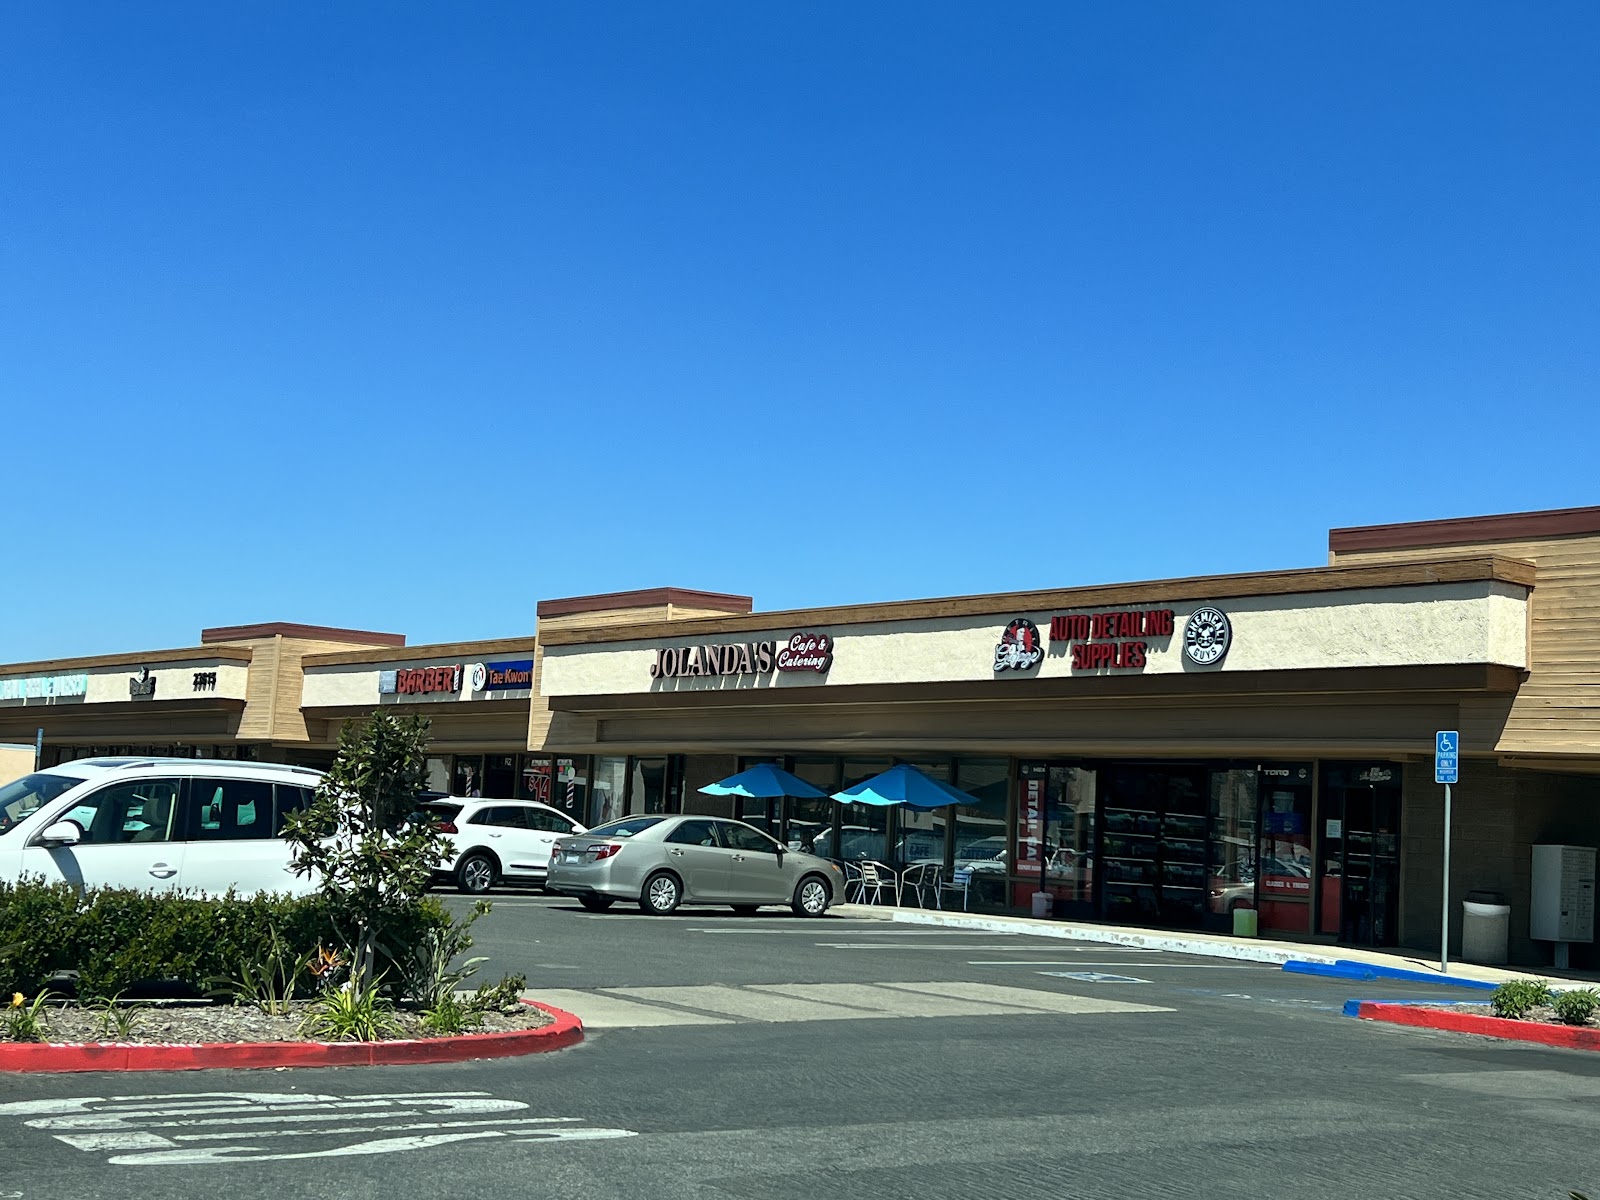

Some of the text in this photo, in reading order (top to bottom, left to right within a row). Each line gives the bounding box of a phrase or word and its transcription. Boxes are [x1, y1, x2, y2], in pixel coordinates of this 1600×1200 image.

[1049, 609, 1174, 641] AUTO DETAILING
[1188, 611, 1225, 643] CHEMICAL
[789, 635, 826, 655] Cafe &
[1071, 641, 1147, 670] SUPPLIES
[1193, 646, 1218, 658] GUYS
[650, 641, 773, 679] JOLANDA'S
[778, 651, 826, 670] Catering
[397, 666, 455, 694] BARBER
[488, 670, 504, 684] Tae
[504, 668, 529, 684] Kwon
[1263, 769, 1290, 777] TORQ
[1027, 779, 1039, 833] DETAIL
[909, 846, 930, 857] CAFE
